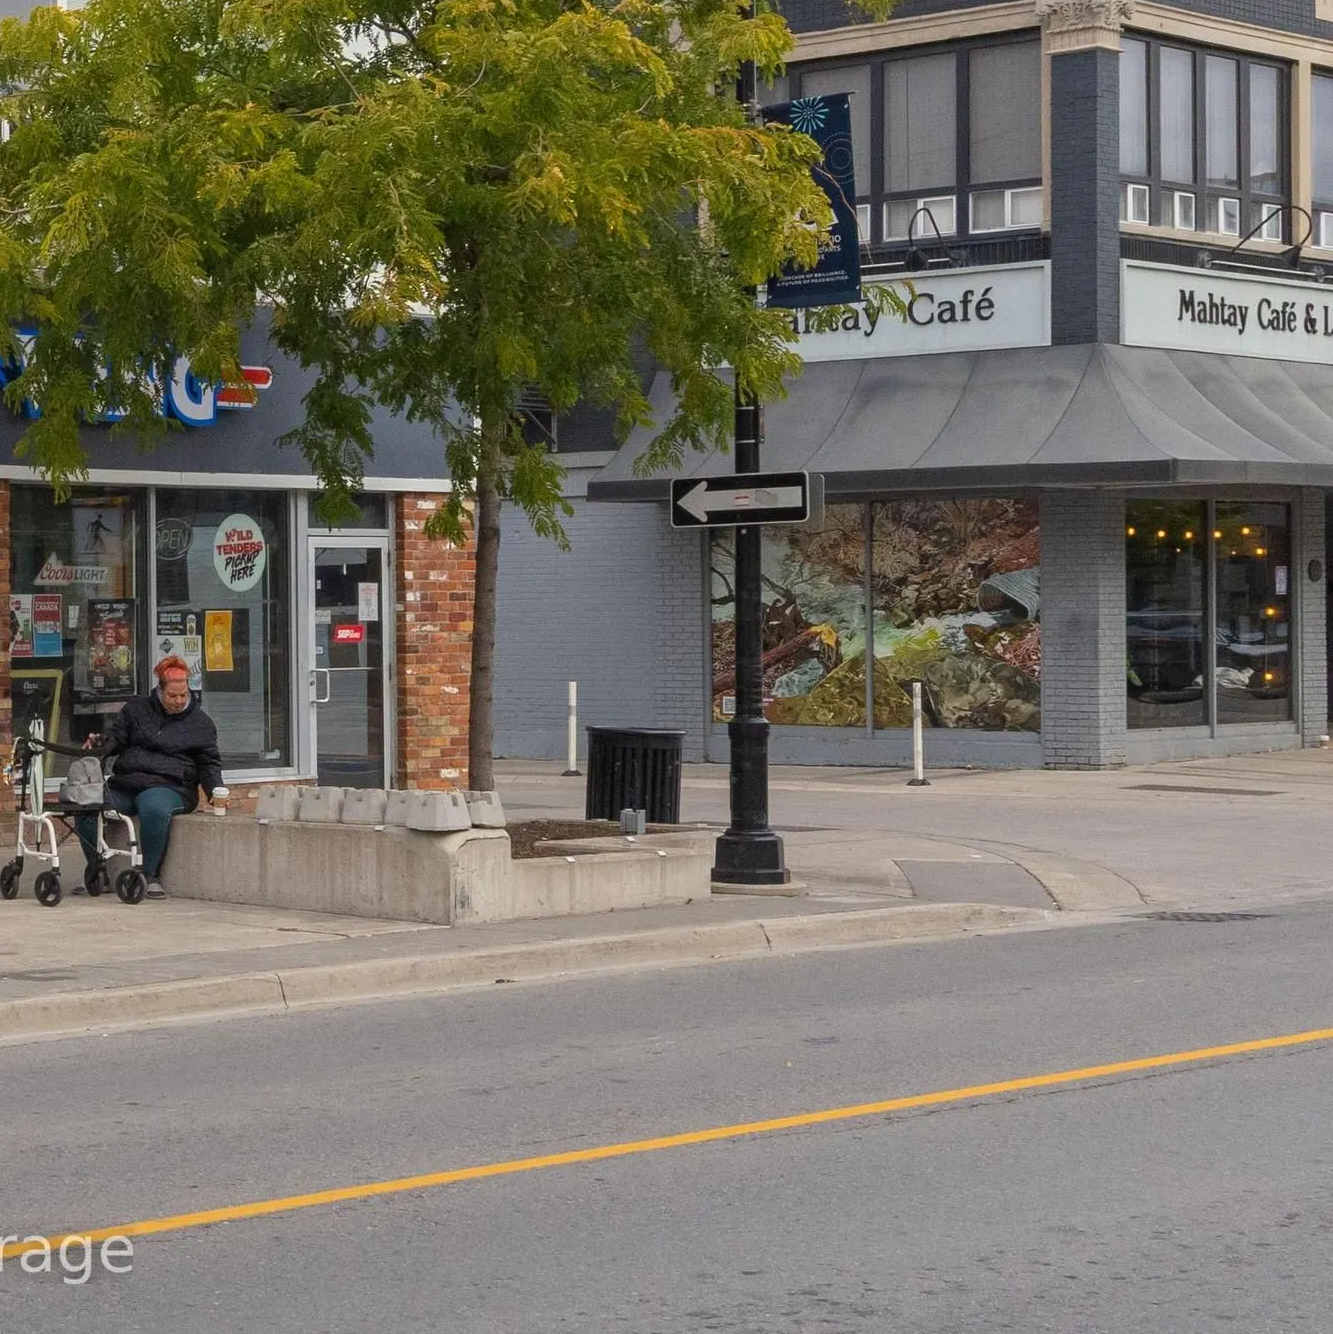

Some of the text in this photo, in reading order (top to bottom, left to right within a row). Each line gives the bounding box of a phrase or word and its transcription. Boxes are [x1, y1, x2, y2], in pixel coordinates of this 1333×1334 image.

[907, 286, 995, 326] Café
[1178, 289, 1249, 335] Mahtay
[1257, 297, 1297, 333] Café
[1304, 302, 1318, 335] &
[225, 528, 253, 542] WILD
[216, 541, 263, 556] TENDERS
[224, 550, 260, 571] PICKUP
[39, 562, 105, 580] Coors LIGHT
[230, 564, 255, 584] HERE
[184, 638, 198, 651] WIN
